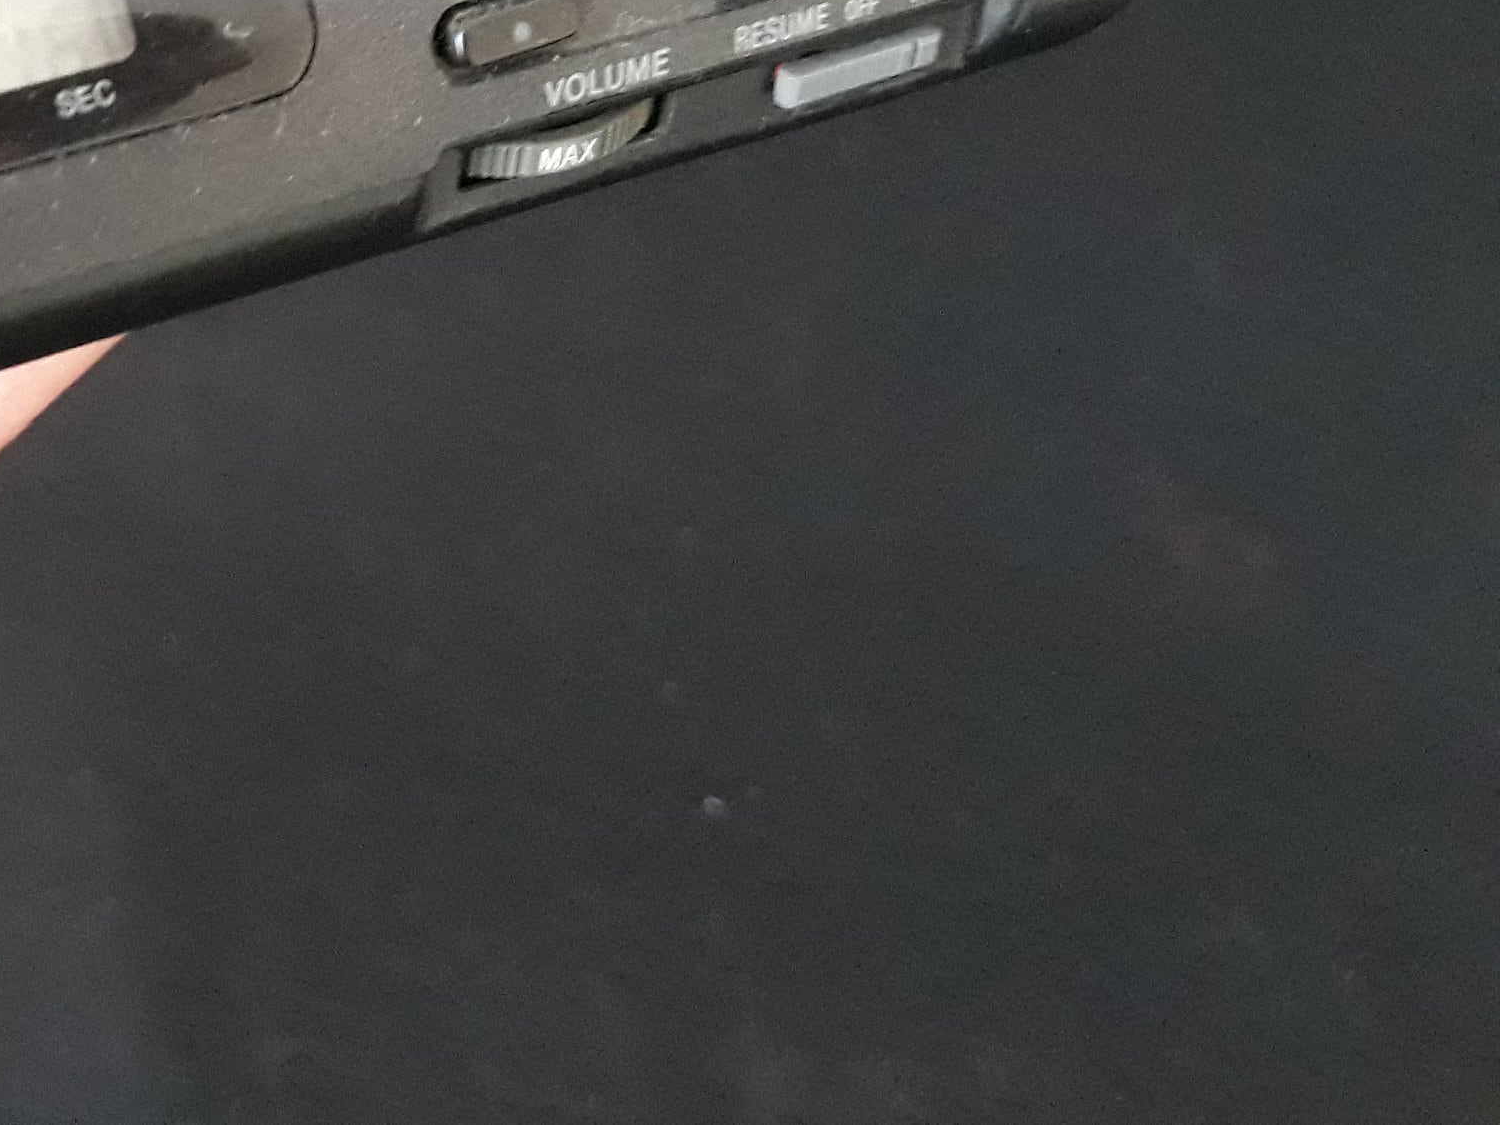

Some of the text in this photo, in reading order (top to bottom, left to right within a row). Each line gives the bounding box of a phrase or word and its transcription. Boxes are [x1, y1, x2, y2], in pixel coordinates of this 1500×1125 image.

[732, 2, 831, 55] RESUME
[52, 77, 117, 120] SEC
[544, 46, 672, 107] VOLUME
[538, 137, 599, 174] MAX
